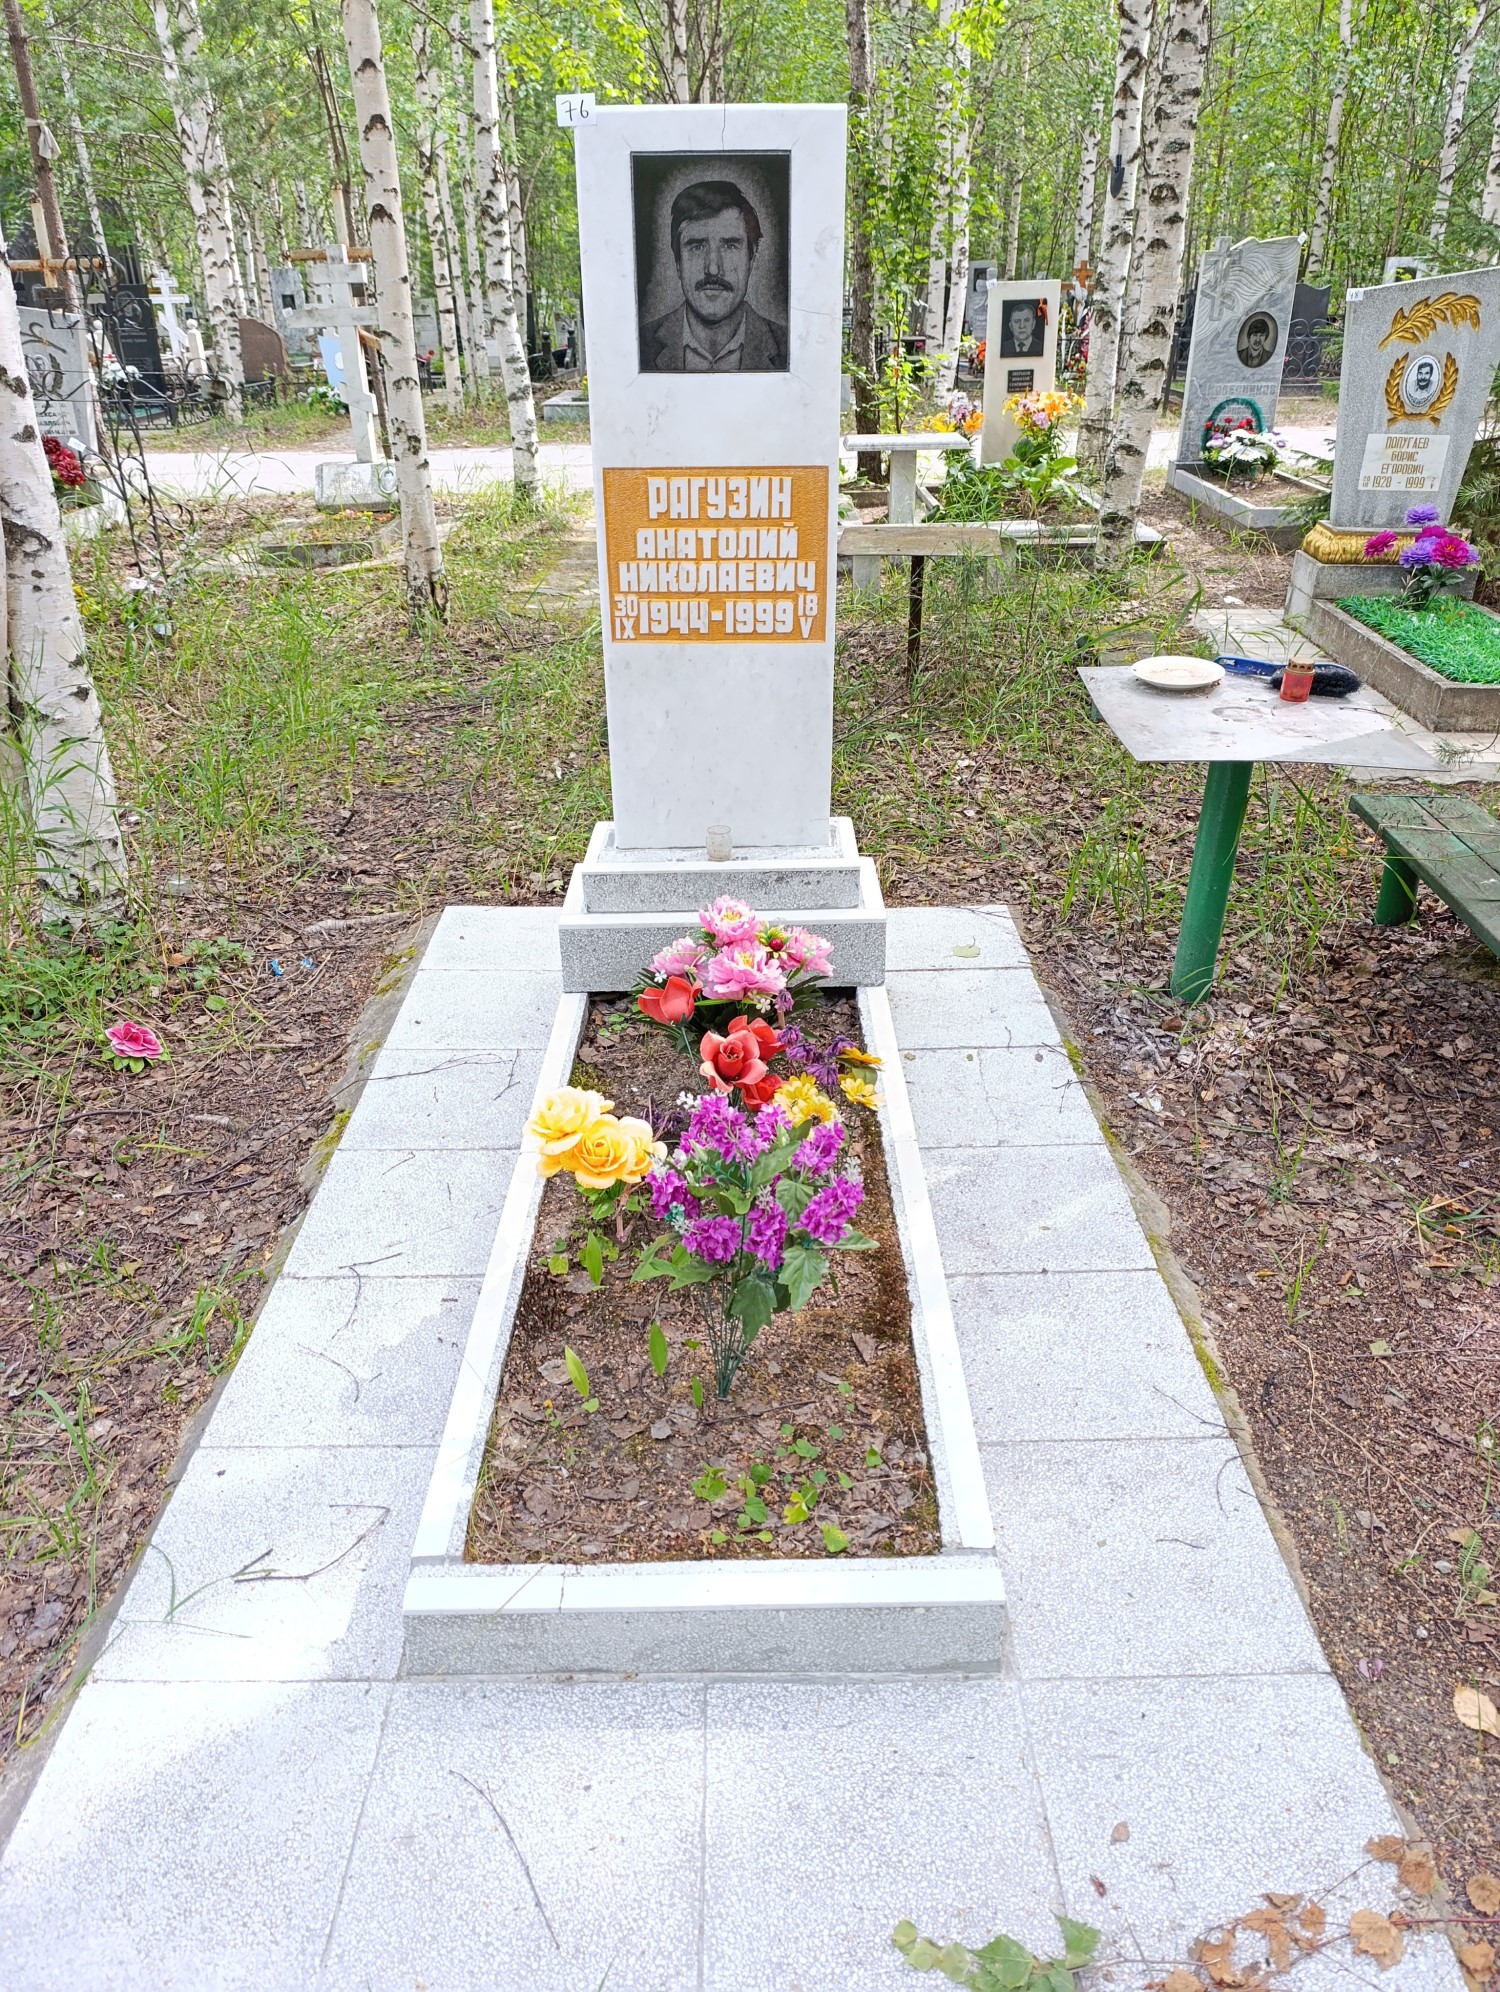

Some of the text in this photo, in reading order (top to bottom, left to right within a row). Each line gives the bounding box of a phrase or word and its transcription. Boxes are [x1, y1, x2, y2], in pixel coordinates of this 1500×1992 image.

[561, 99, 589, 121] 76
[1385, 436, 1430, 449] ПОПУГАЕВ
[1391, 451, 1419, 461] БОРИС
[1380, 463, 1424, 475] ЕГОРОВИЧ
[648, 477, 793, 519] РАГУЗИН
[636, 522, 799, 559] АНАТОЛИЙ
[618, 561, 816, 592] НИКОЛАЕВИЧ
[614, 594, 638, 617] 30
[797, 593, 818, 617] 18
[614, 618, 636, 639] IX
[799, 617, 814, 639] V
